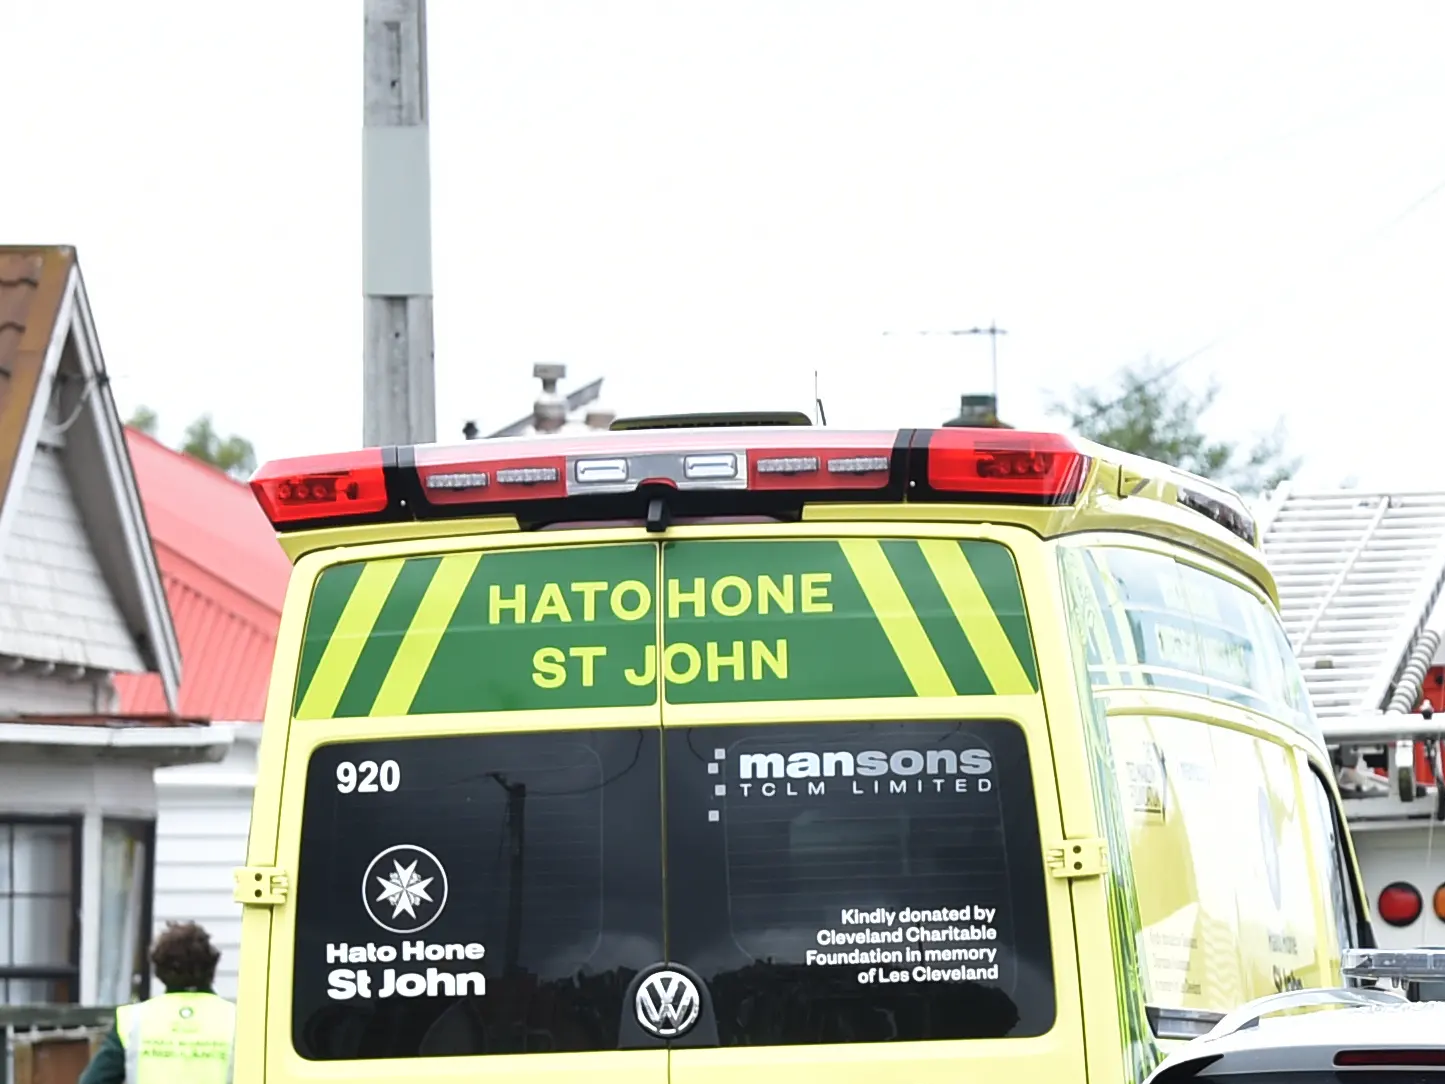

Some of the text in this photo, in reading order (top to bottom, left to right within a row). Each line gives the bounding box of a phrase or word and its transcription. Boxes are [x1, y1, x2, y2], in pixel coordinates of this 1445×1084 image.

[488, 572, 834, 625] HATO HONE
[531, 638, 790, 689] ST JOHN
[738, 747, 993, 778] mansons
[335, 760, 401, 794] 920
[739, 777, 994, 797] TCLM LIMITED
[840, 905, 996, 926] Kindly donated by
[816, 925, 997, 946] Cleveland Charitable
[326, 938, 485, 963] Hato Hone
[805, 946, 998, 966] Foundation in memory
[327, 965, 486, 1000] St John
[857, 963, 999, 984] of Les Cleveland
